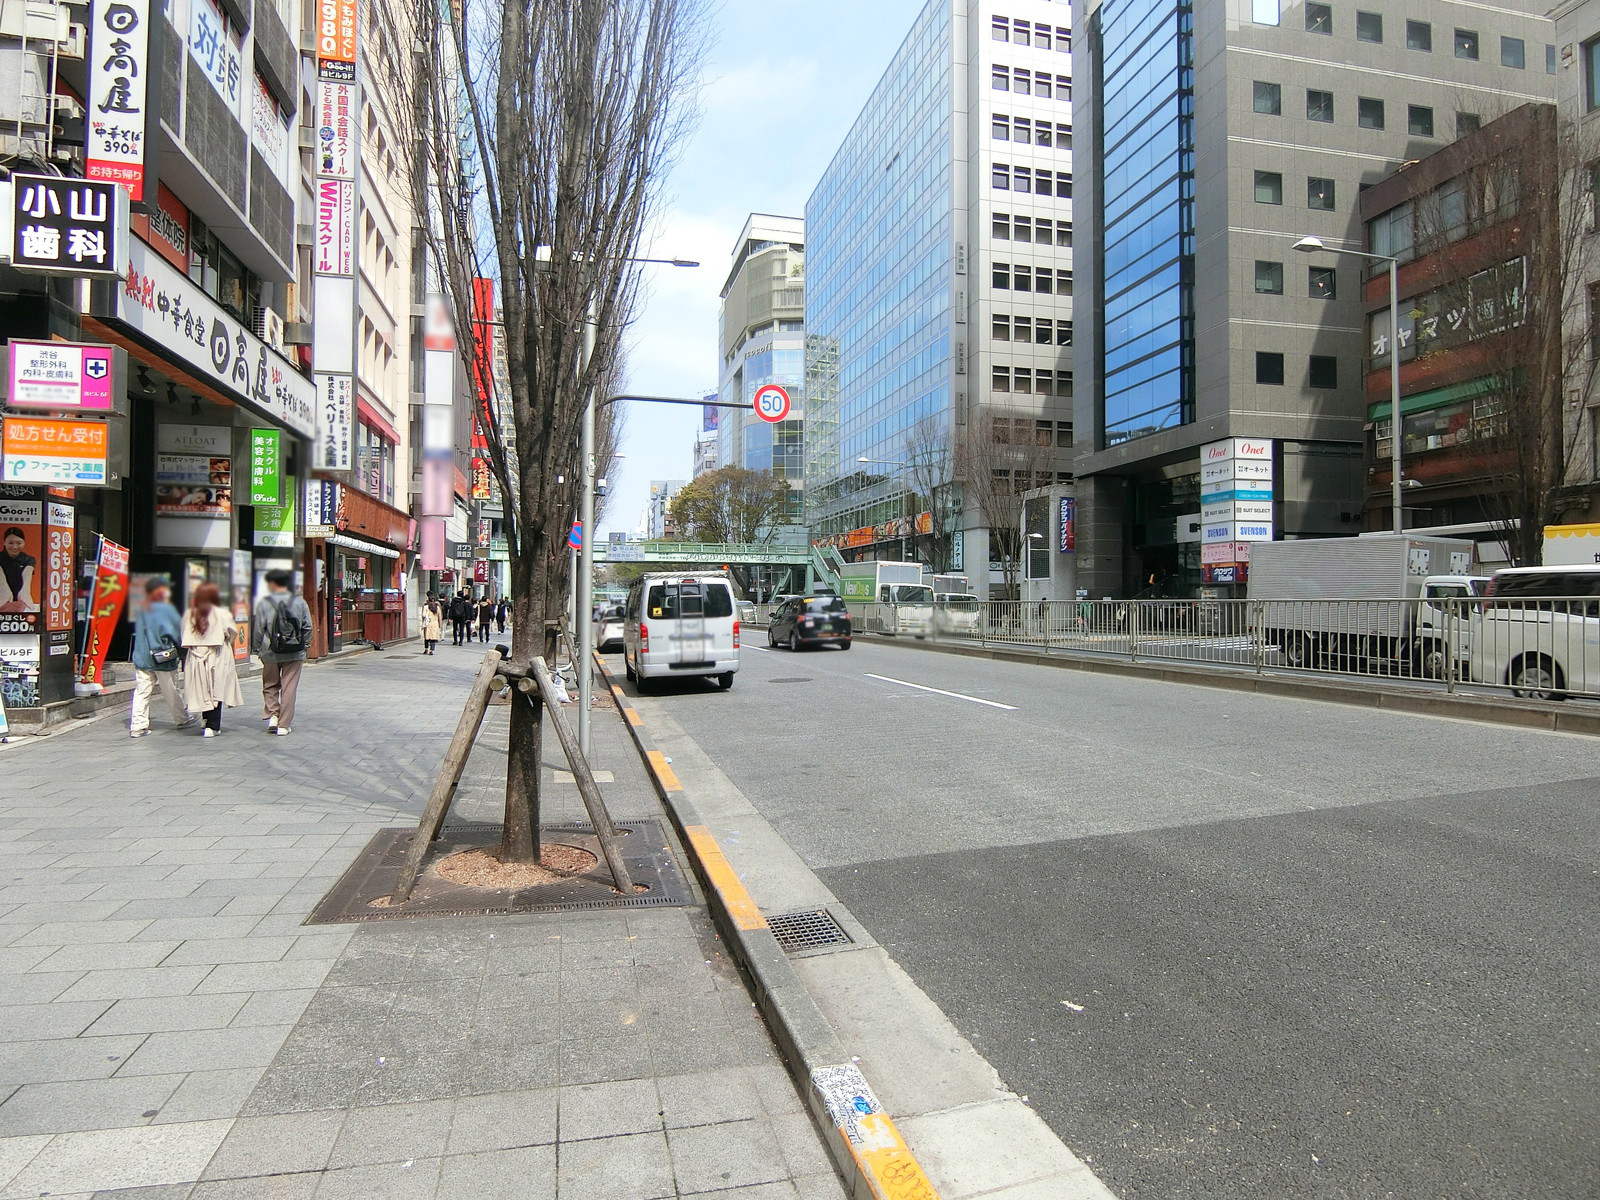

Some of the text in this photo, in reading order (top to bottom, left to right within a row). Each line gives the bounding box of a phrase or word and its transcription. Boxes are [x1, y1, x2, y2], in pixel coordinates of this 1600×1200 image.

[322, 82, 332, 126] こども英会話
[95, 126, 143, 142] 中華そば
[337, 85, 348, 175] 外国語会話スクール
[90, 166, 142, 181] お持ち帰り
[21, 184, 107, 222] 小山
[319, 181, 338, 271] Winスクール
[21, 227, 107, 264] 歯科
[30, 359, 67, 369] 整形外科
[39, 350, 58, 359] 渋谷
[23, 369, 73, 379] 内科・皮膚科
[762, 395, 782, 412] 50
[9, 424, 104, 445] 処方せん受付
[325, 403, 337, 467] ベリース企画
[265, 437, 275, 475] オラクル
[1208, 447, 1227, 459] Onet
[1241, 443, 1265, 454] Onet
[31, 460, 104, 473] ファーコス薬局
[254, 436, 264, 486] 美容皮膚科
[323, 481, 332, 524] トランクルーム
[1207, 527, 1228, 538] SVENSON
[1240, 526, 1267, 536] SVENSON
[62, 550, 71, 627] もみほぐし
